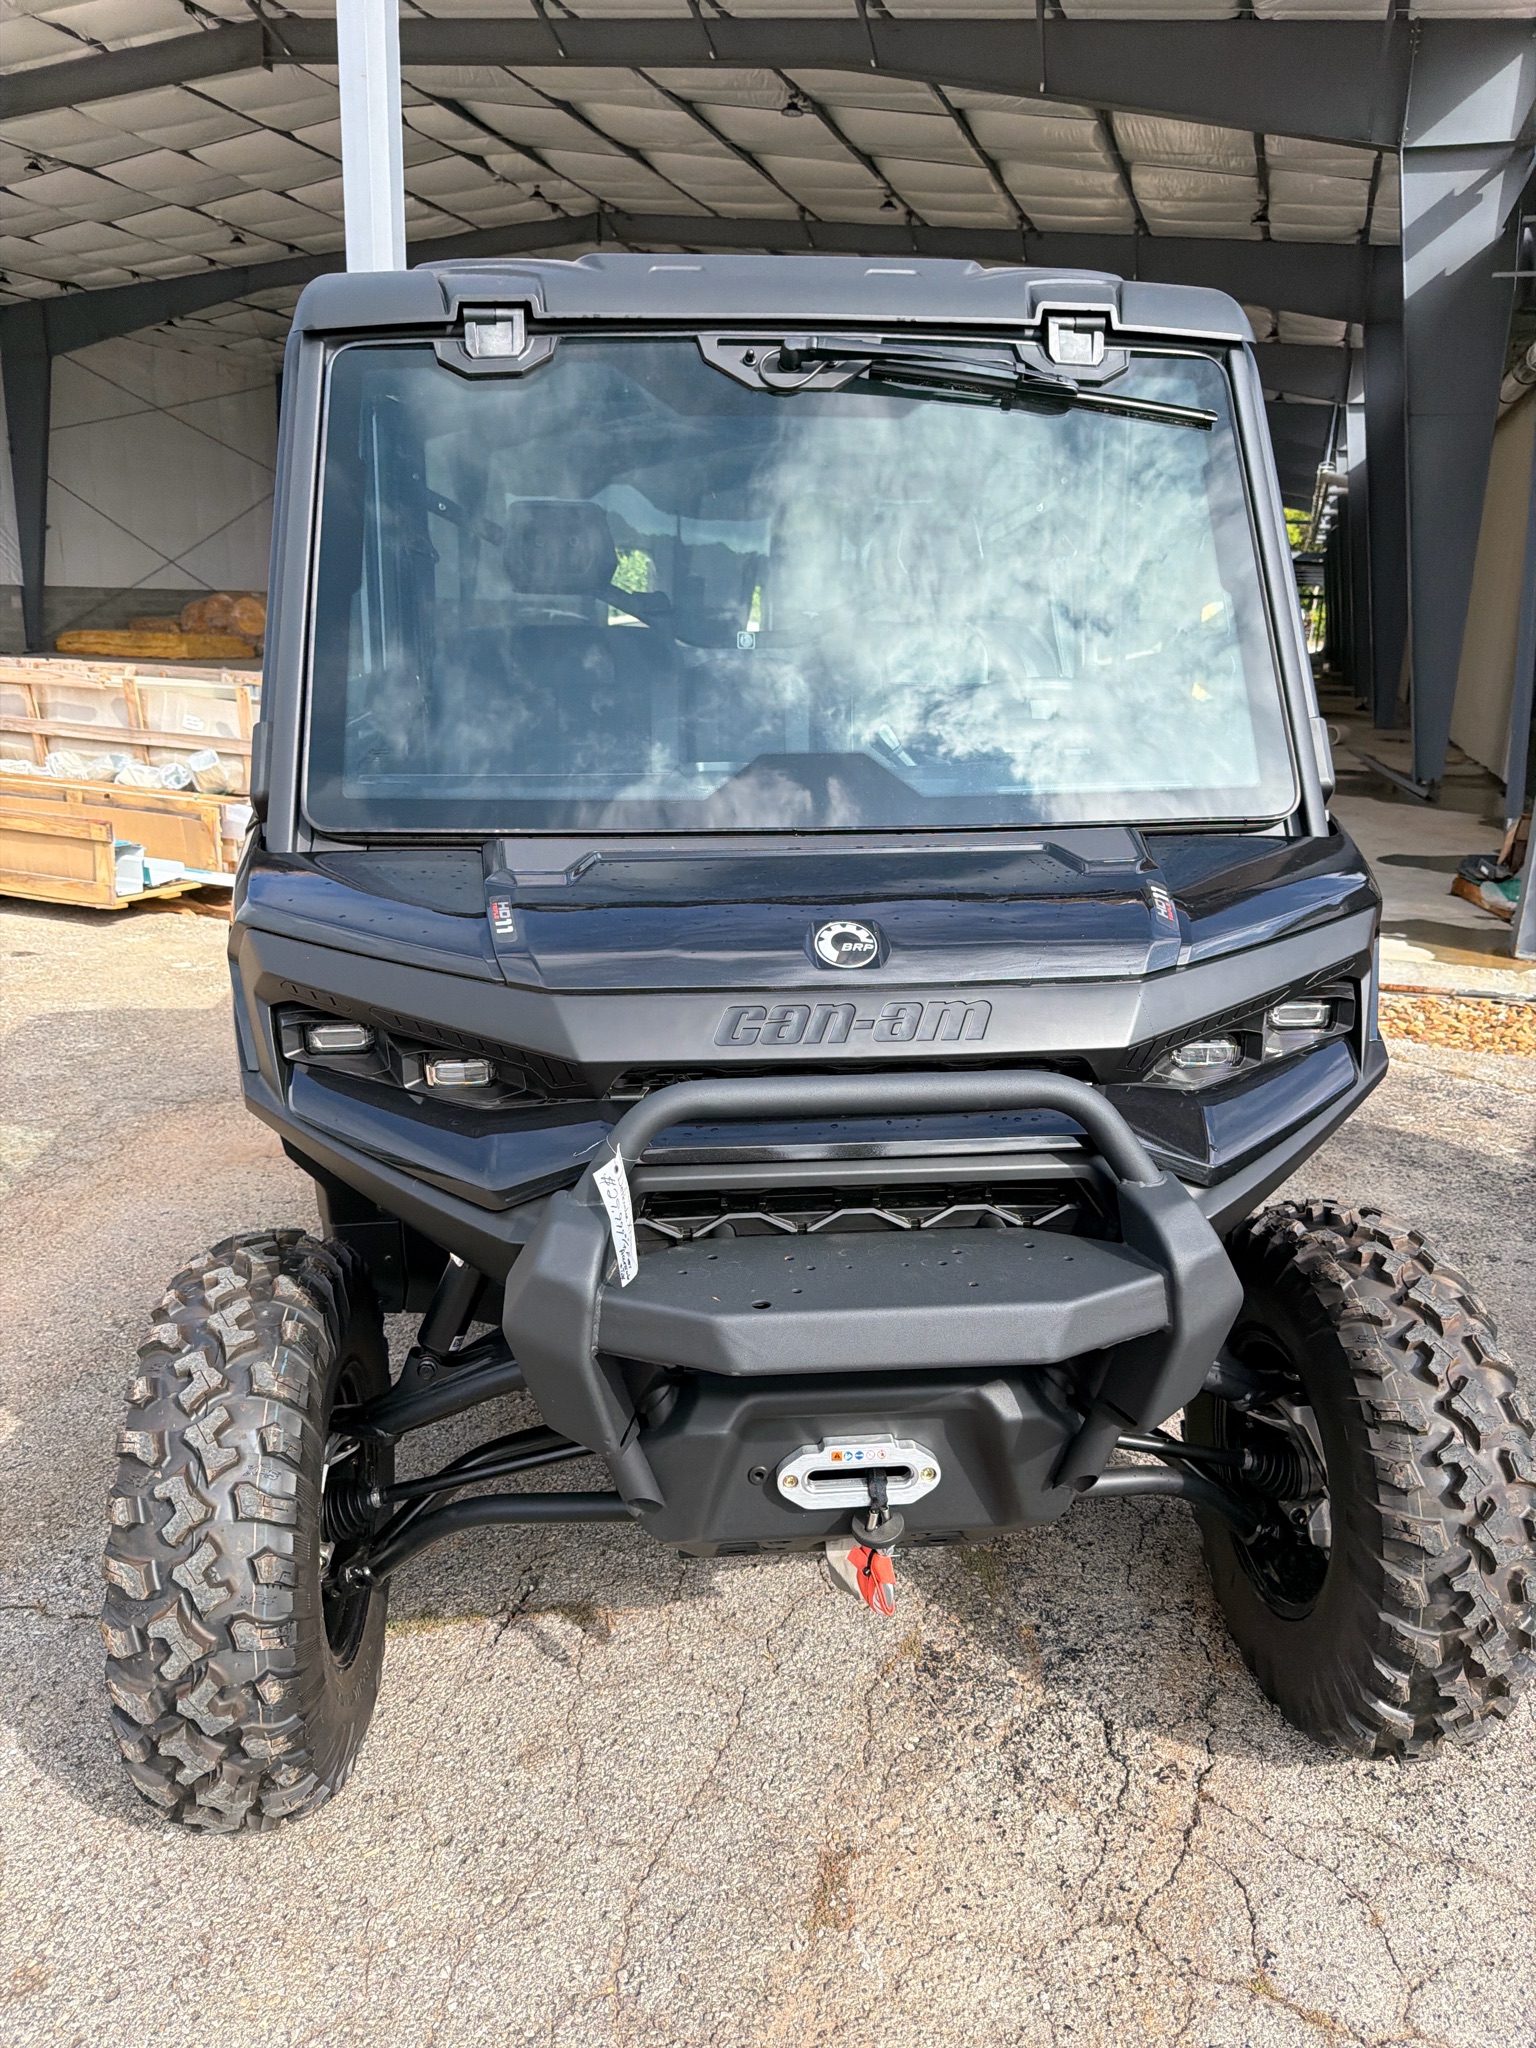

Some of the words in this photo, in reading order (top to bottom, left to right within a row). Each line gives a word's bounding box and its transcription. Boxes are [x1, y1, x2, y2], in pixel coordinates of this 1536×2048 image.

[494, 902, 513, 934] HD11
[1150, 886, 1170, 919] HD11
[841, 942, 875, 952] BRP
[713, 1000, 993, 1047] can-am
